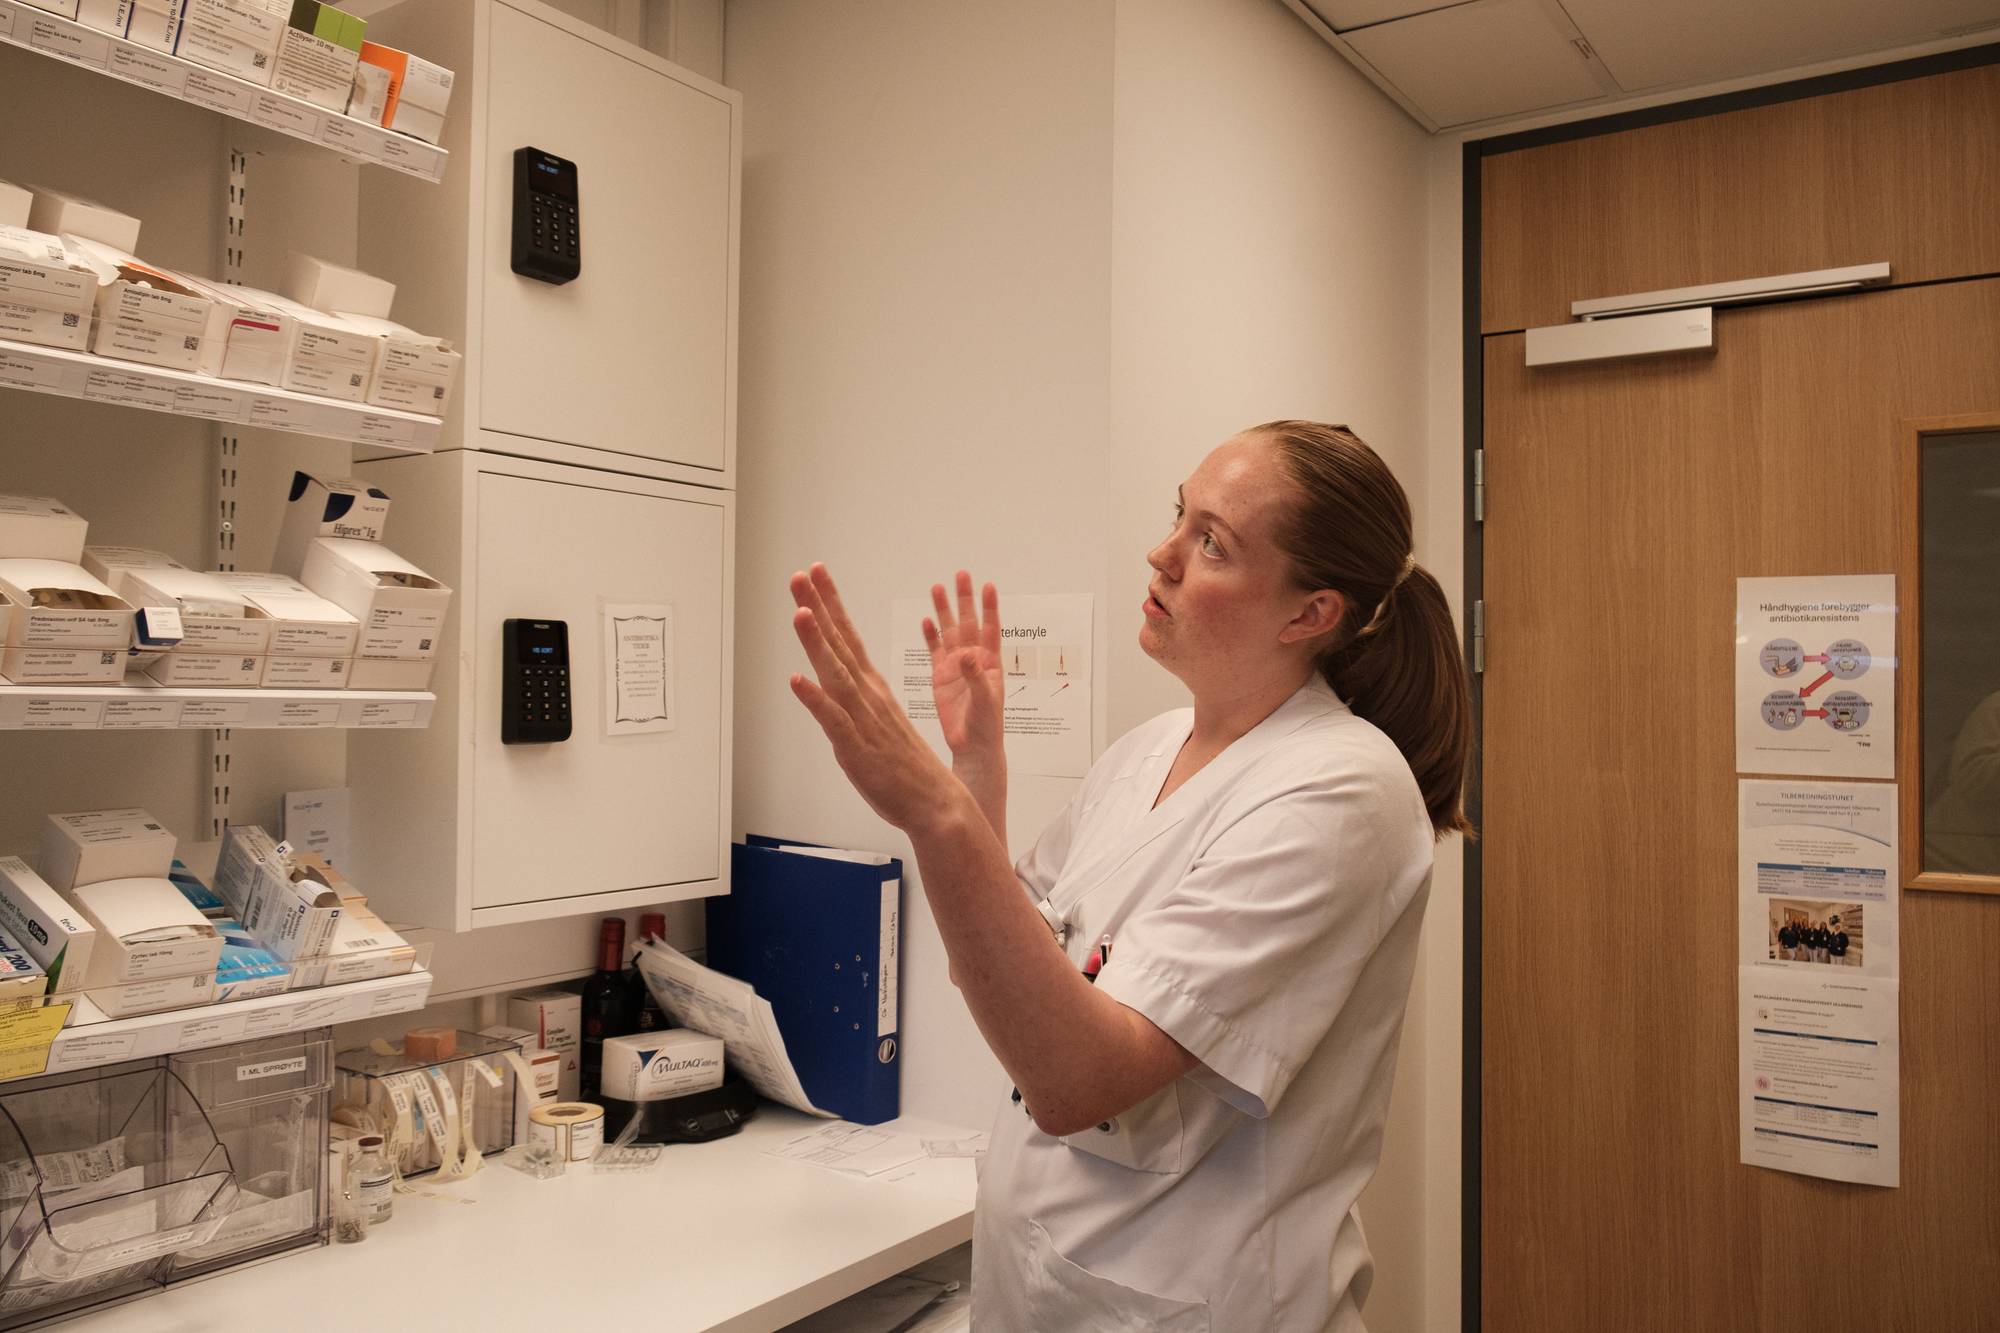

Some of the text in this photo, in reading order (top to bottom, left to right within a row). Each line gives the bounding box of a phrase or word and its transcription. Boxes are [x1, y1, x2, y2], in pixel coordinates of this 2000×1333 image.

[1759, 601, 1871, 616] Håndhygiene forebygger
[1769, 613, 1860, 623] antibiotikaresistens
[1001, 625, 1047, 640] terkanyle
[656, 1058, 700, 1074] MULTAQ
